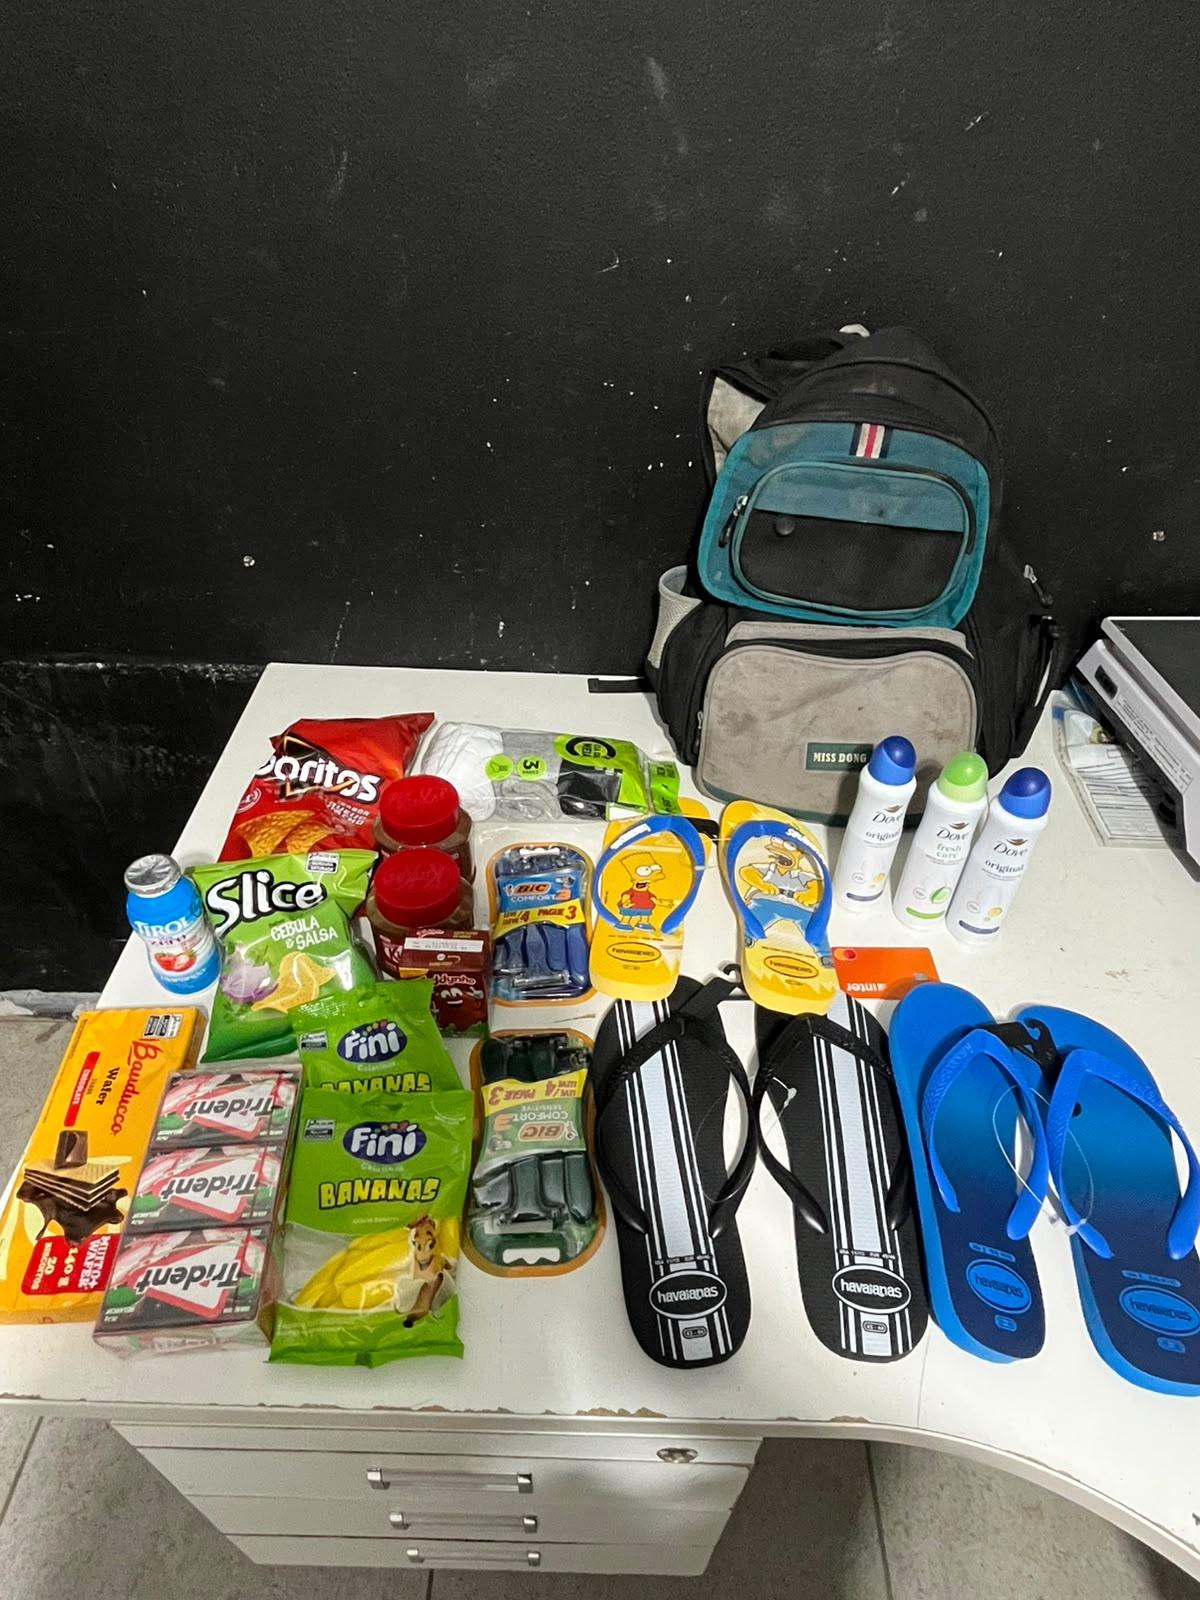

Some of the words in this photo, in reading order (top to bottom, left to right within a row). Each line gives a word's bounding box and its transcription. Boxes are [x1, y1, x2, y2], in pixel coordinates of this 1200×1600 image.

[523, 760, 540, 770] 3
[813, 752, 837, 763] MISS
[838, 753, 867, 763] DONG
[872, 811, 903, 824] Dove
[937, 828, 969, 841] Dove
[937, 843, 962, 853] fresh
[993, 842, 1029, 857] Dove
[985, 859, 1025, 873] original
[517, 883, 549, 894] BIC
[206, 869, 325, 939] Slice
[565, 905, 577, 920] 3
[285, 936, 296, 949] &
[295, 927, 339, 950] SALSA
[846, 983, 880, 993] inter
[345, 1023, 400, 1060] Fini
[96, 1067, 120, 1105] Wafer
[110, 1039, 164, 1136] Bauducco
[489, 1086, 504, 1105] 3
[503, 1089, 536, 1100] PAGUE
[184, 1097, 273, 1120] Trident
[512, 1111, 569, 1121] COMFORT
[351, 1124, 418, 1157] Fini
[522, 1125, 561, 1138] BIC
[160, 1174, 259, 1200] Trident
[319, 1177, 441, 1209] BANANAS
[45, 1256, 57, 1275] 20
[64, 1247, 79, 1274] 140
[136, 1262, 239, 1292] Trident
[974, 1272, 1025, 1299] havaianas
[657, 1286, 719, 1303] havaianas
[840, 1278, 903, 1298] havaianas
[1129, 1297, 1193, 1322] havaianas
